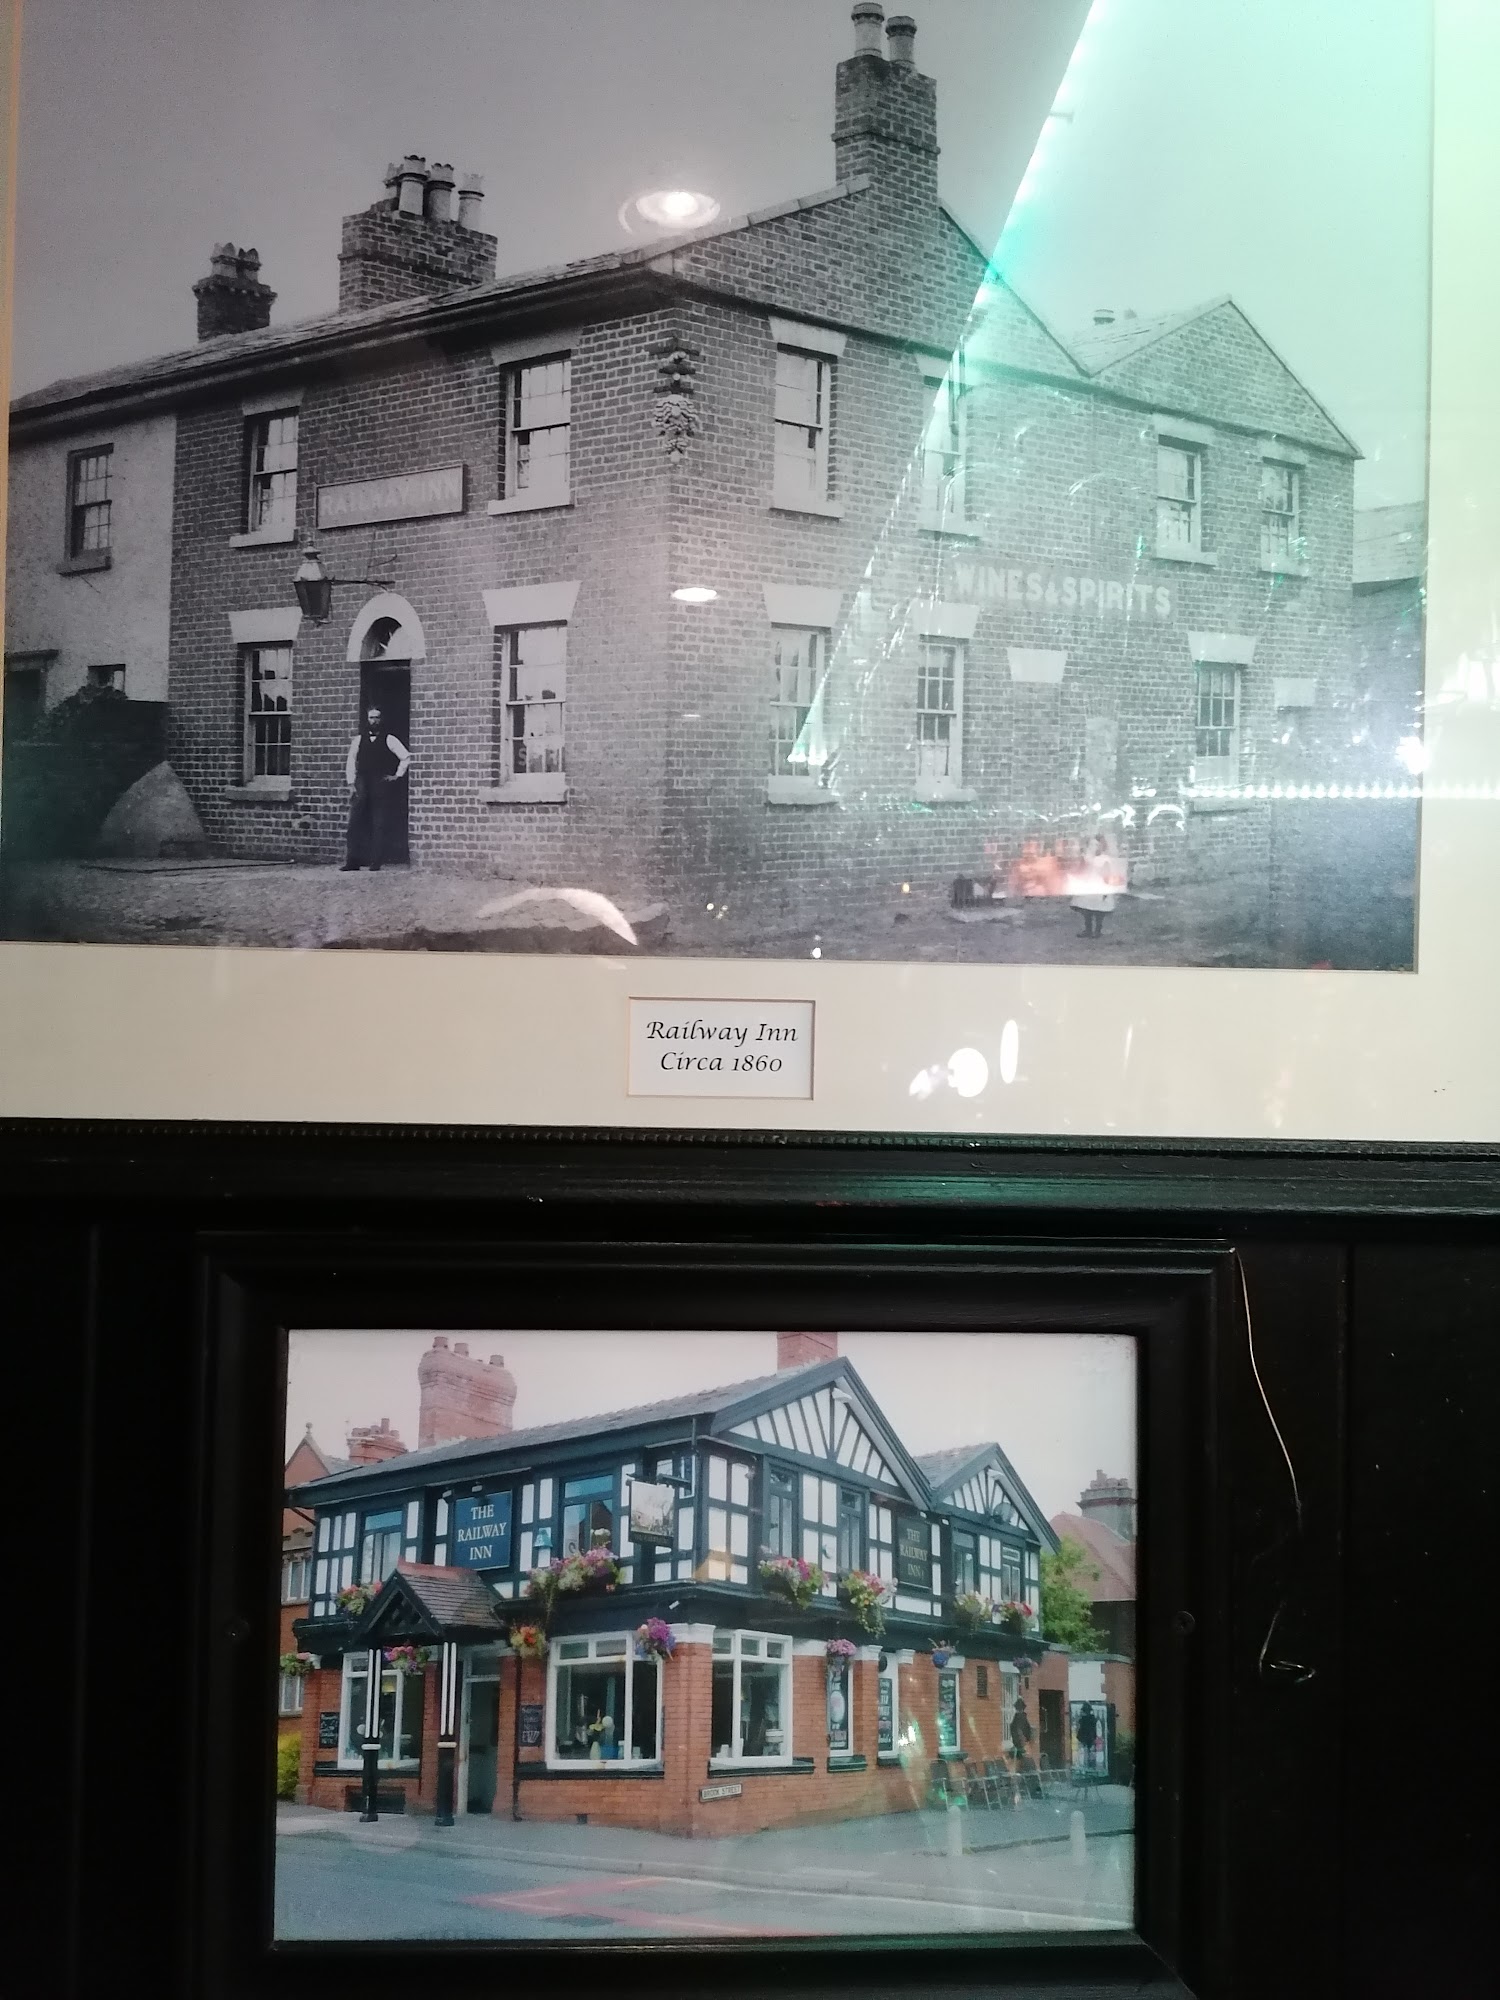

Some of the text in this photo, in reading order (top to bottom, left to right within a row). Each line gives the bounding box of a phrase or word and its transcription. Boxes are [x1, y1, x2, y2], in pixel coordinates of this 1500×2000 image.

[646, 1019, 798, 1048] Railway Inn
[660, 1051, 782, 1072] Circa 1860
[470, 1503, 495, 1520] THE
[457, 1522, 507, 1543] RAILWAY
[906, 1528, 920, 1542] THE
[469, 1544, 493, 1561] INN
[900, 1544, 928, 1561] RAILWAY
[908, 1563, 924, 1579] INN
